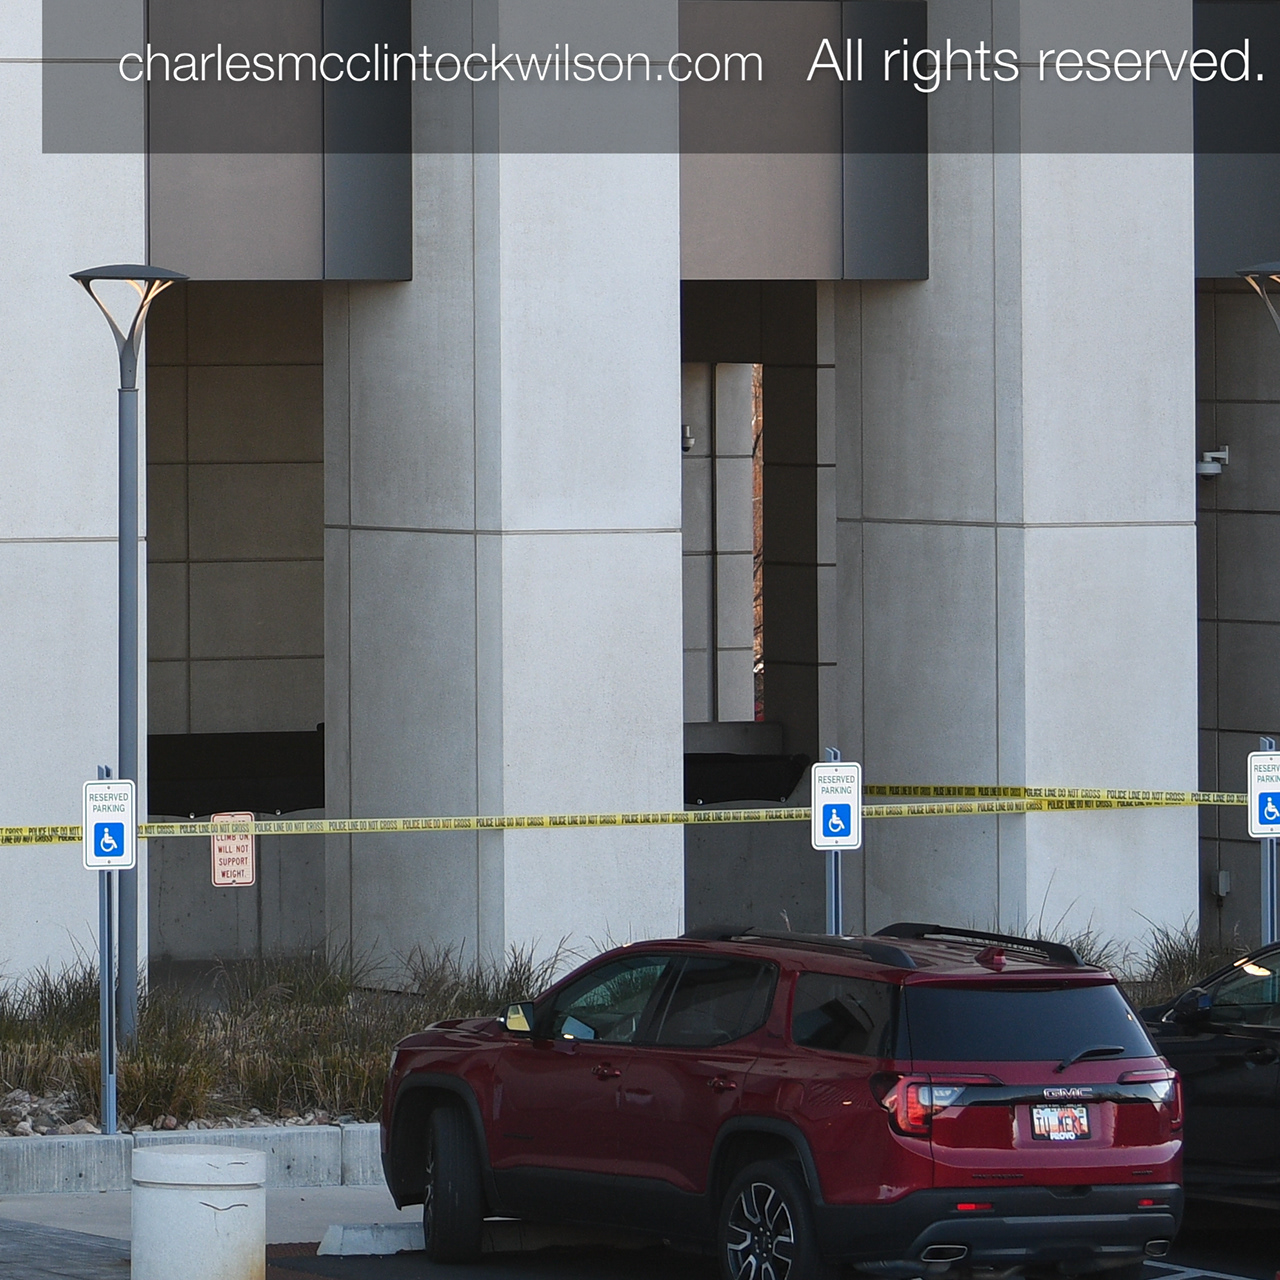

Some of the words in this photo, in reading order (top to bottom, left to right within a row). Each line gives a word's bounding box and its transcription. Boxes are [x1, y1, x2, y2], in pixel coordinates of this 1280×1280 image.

[1254, 765, 1280, 773] RESERV
[818, 775, 856, 784] RESERVED
[1257, 775, 1280, 783] PARKIN
[821, 786, 852, 794] PARKING
[1024, 787, 1044, 797] POLICE
[1045, 788, 1058, 797] LINE
[1058, 788, 1067, 798] DO
[1068, 788, 1080, 798] NOT
[1081, 789, 1101, 799] CROSS
[89, 793, 129, 802] RESERVED
[1107, 790, 1127, 800] POLICE
[1128, 790, 1141, 801] LINE
[1142, 790, 1150, 801] DO
[1152, 791, 1164, 801] NOT
[1165, 791, 1185, 802] CROSS
[1191, 792, 1211, 803] POLICE
[1212, 793, 1225, 803] LINE
[1226, 793, 1234, 803] DO
[1236, 793, 1248, 804] NOT
[92, 804, 125, 813] PARKING
[621, 814, 639, 824] POLICE
[640, 813, 651, 823] LINE
[651, 813, 659, 823] DO
[660, 813, 671, 823] NOT
[672, 813, 689, 822] CROSS
[693, 812, 711, 822] POLICE
[712, 811, 723, 821] LINE
[723, 811, 731, 821] DO
[732, 811, 742, 821] NOT
[743, 810, 761, 820] CROSS
[402, 819, 420, 830] POLICE
[421, 819, 433, 829] LINE
[433, 819, 441, 829] DO
[442, 818, 452, 829] NOT
[454, 818, 471, 828] CROSS
[476, 817, 494, 828] POLICE
[495, 817, 506, 827] LINE
[506, 817, 514, 827] DO
[515, 816, 526, 827] NOT
[527, 816, 544, 826] CROSS
[180, 824, 198, 834] POLICE
[199, 824, 210, 834] LINE
[211, 824, 219, 833] DO
[220, 823, 230, 833] NOT
[232, 823, 249, 833] CROSS
[218, 845, 233, 854] WILL
[235, 844, 249, 853] NOT
[218, 856, 249, 866] SUPPORT
[1043, 1087, 1094, 1100] GMC
[1035, 1116, 1051, 1134] TU
